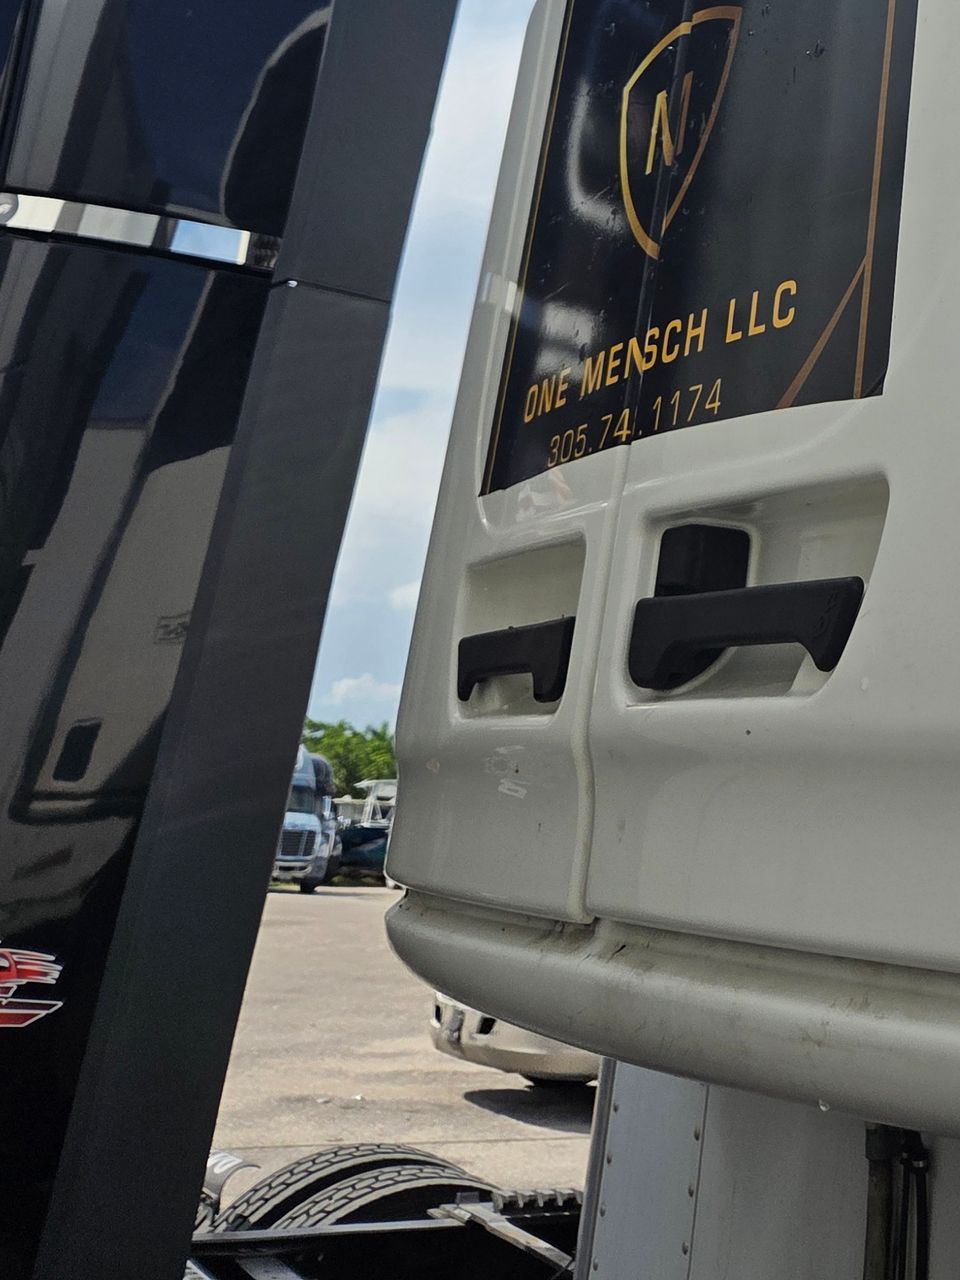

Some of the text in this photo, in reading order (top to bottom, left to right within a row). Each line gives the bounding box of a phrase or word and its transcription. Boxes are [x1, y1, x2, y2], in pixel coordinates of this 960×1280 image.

[523, 279, 797, 424] ONE MENSCH LLC
